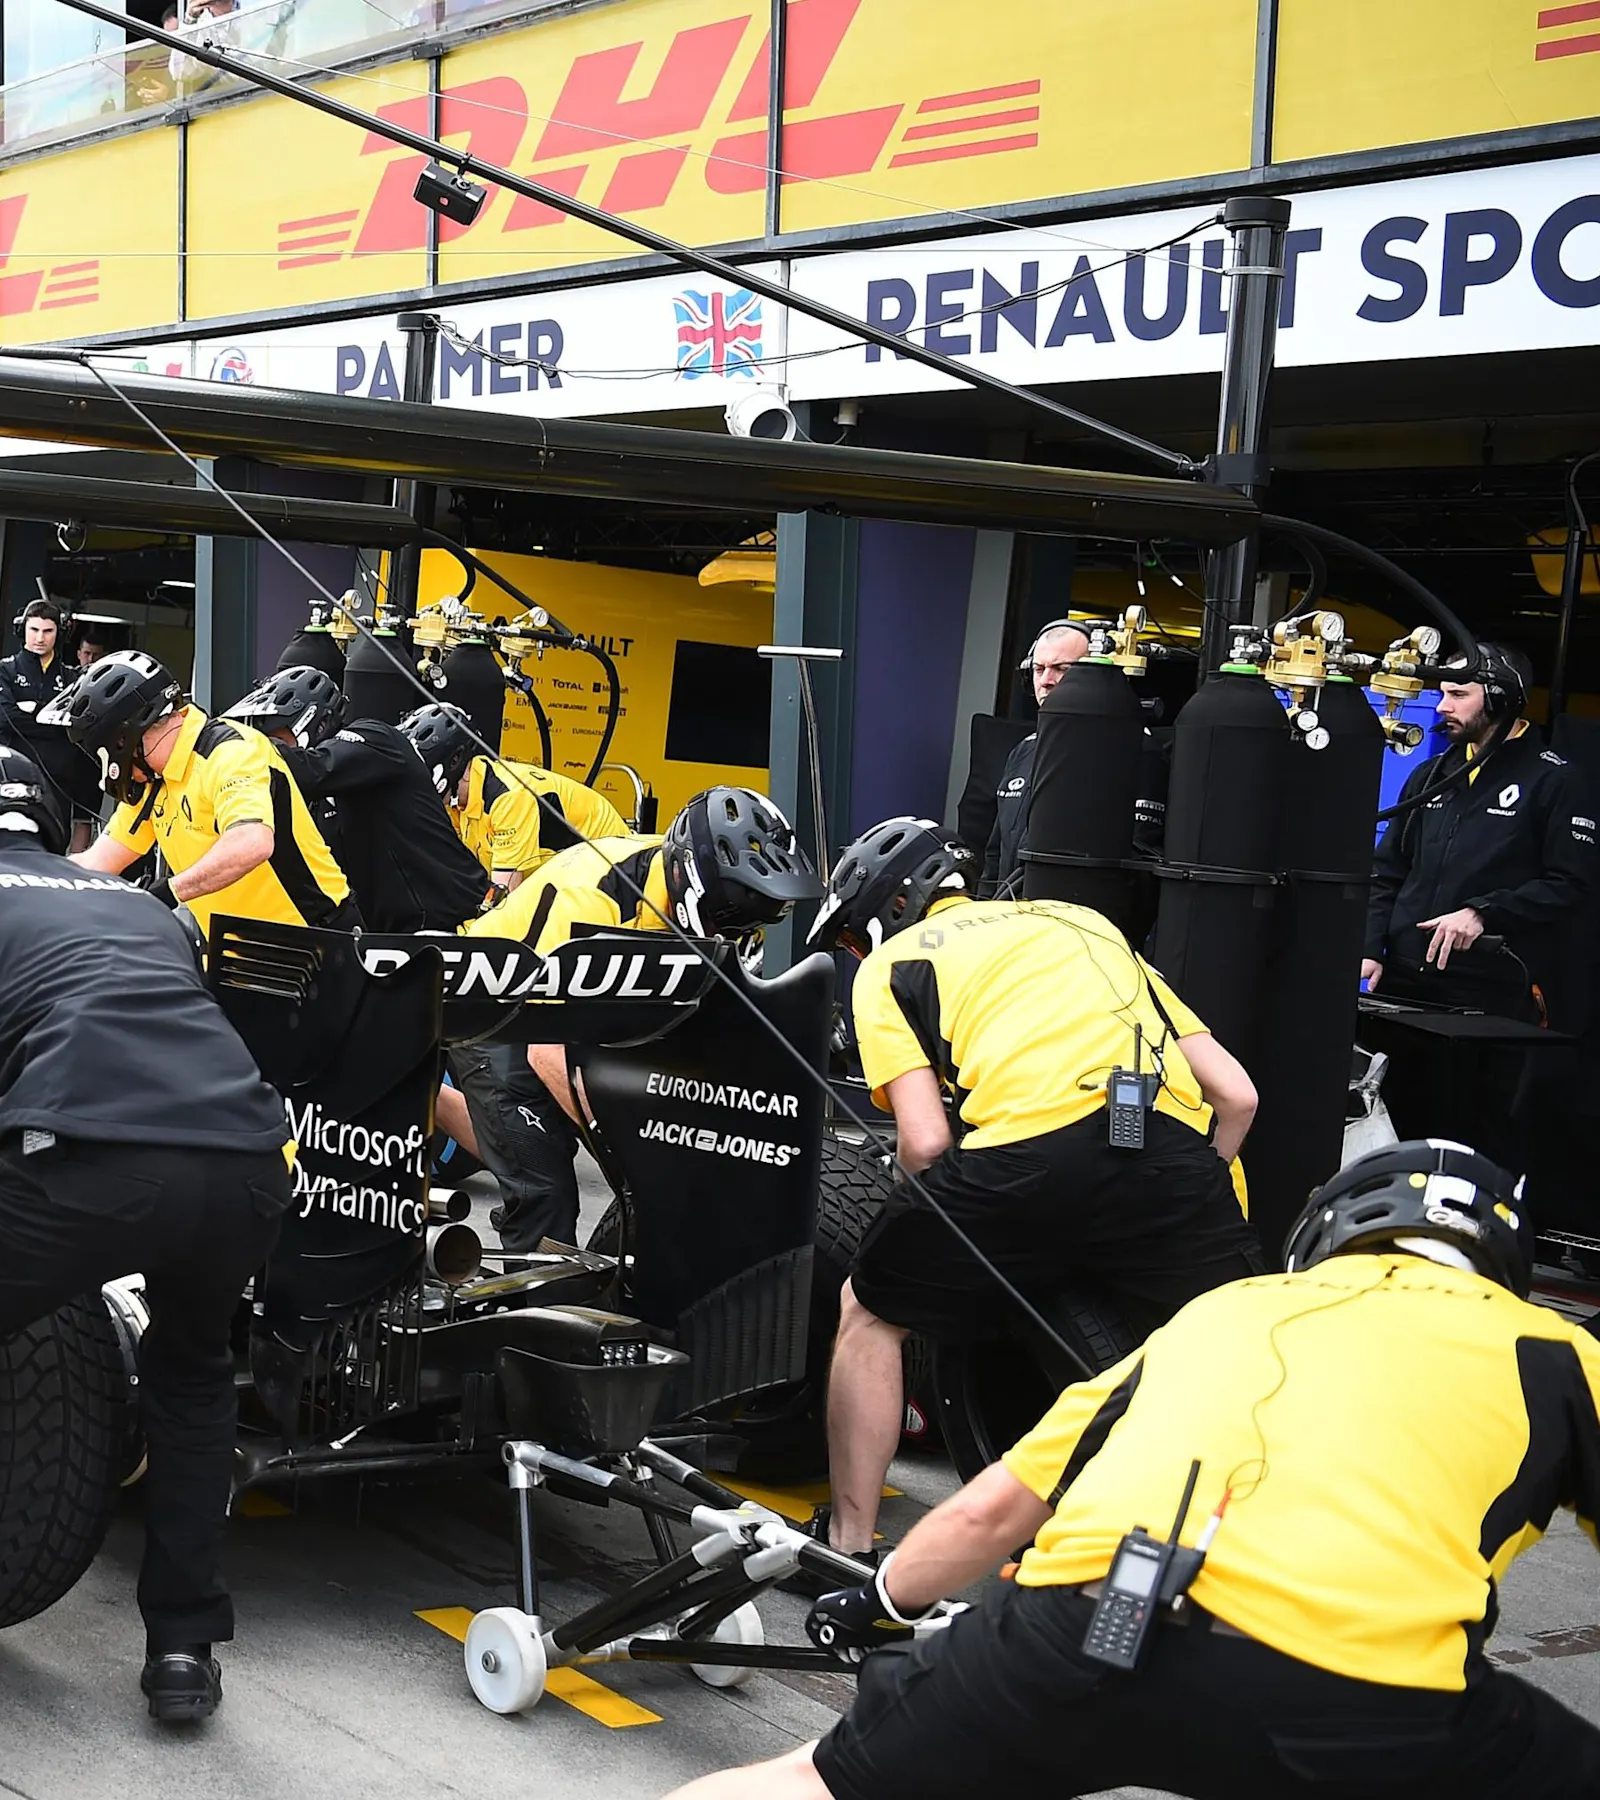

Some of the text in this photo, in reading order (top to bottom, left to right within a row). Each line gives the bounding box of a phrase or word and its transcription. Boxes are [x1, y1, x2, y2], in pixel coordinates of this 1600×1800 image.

[353, 0, 904, 258] DHL
[865, 227, 1322, 363] RENAULT
[335, 317, 565, 401] PAMER
[552, 678, 584, 691] TOTAL
[1135, 813, 1164, 825] TOTAL
[645, 1072, 799, 1117] EURODATACAR
[285, 1097, 425, 1178] Microsoft
[290, 1158, 427, 1239] Dynamics
